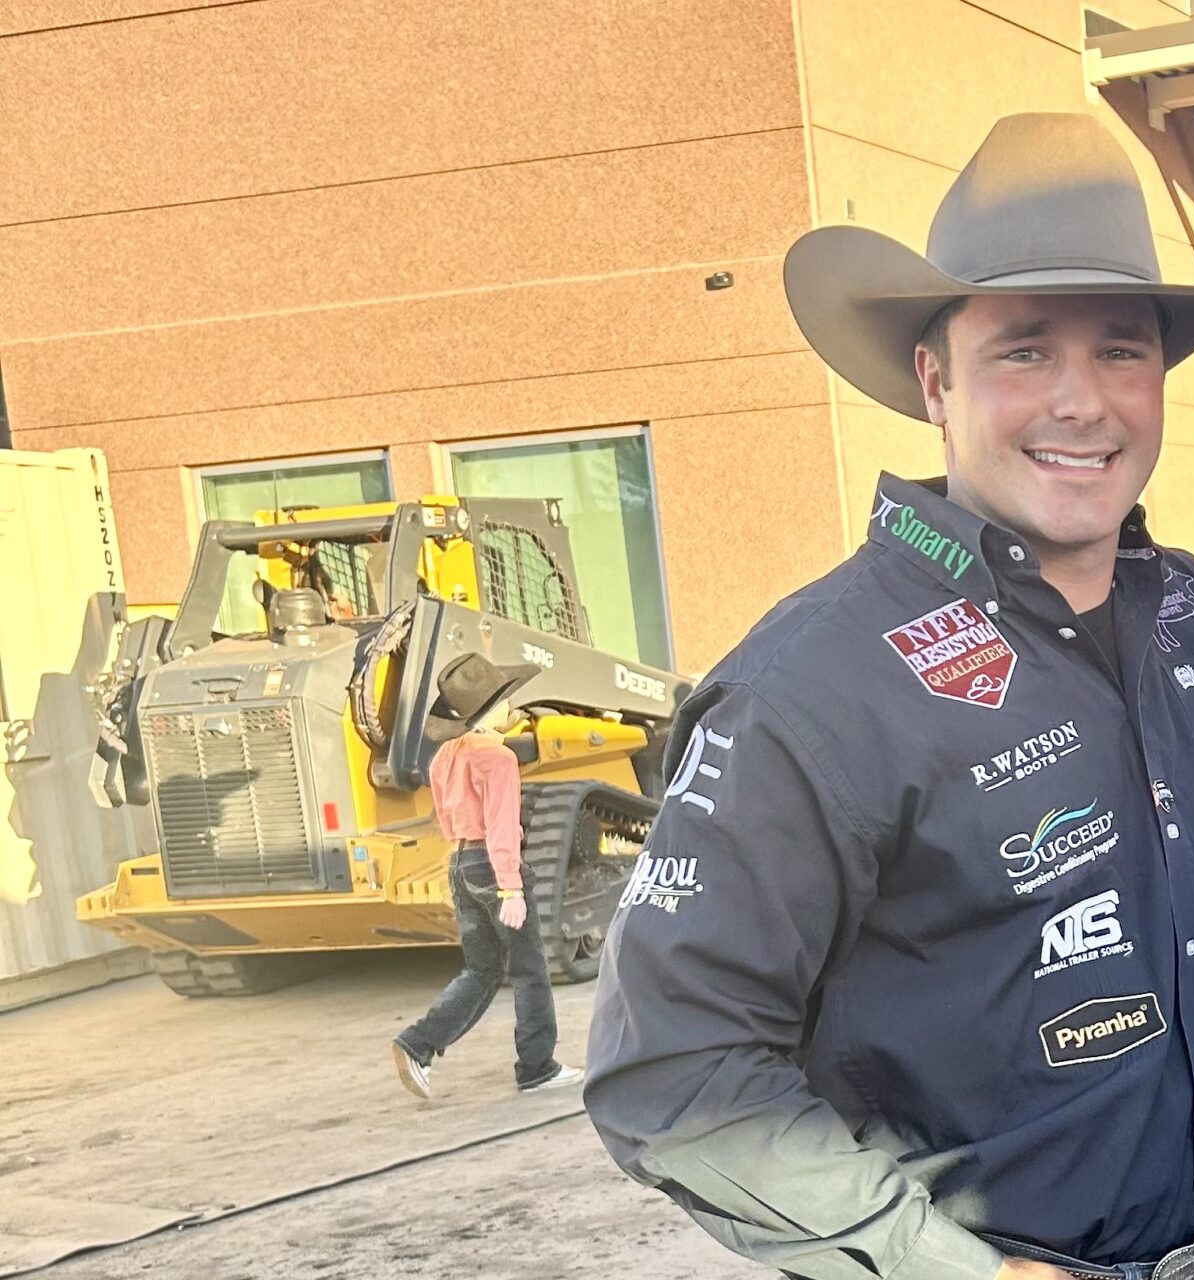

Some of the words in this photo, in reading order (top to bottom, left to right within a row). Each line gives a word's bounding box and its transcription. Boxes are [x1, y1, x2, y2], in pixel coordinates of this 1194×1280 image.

[892, 505, 974, 580] Smarty
[900, 604, 977, 650] NFR
[906, 623, 998, 673] RESISTOL
[927, 643, 1010, 688] QUALIFIER
[614, 662, 666, 701] DEERE
[1015, 753, 1057, 780] BOOTS
[1013, 870, 1057, 895] Digestive
[648, 894, 680, 912] RUM
[1040, 889, 1123, 965] NTS
[1034, 959, 1068, 979] NATIONAL
[1068, 950, 1099, 967] TRAILER
[1101, 941, 1134, 957] SOURCE
[1055, 1010, 1147, 1049] Pyranha
